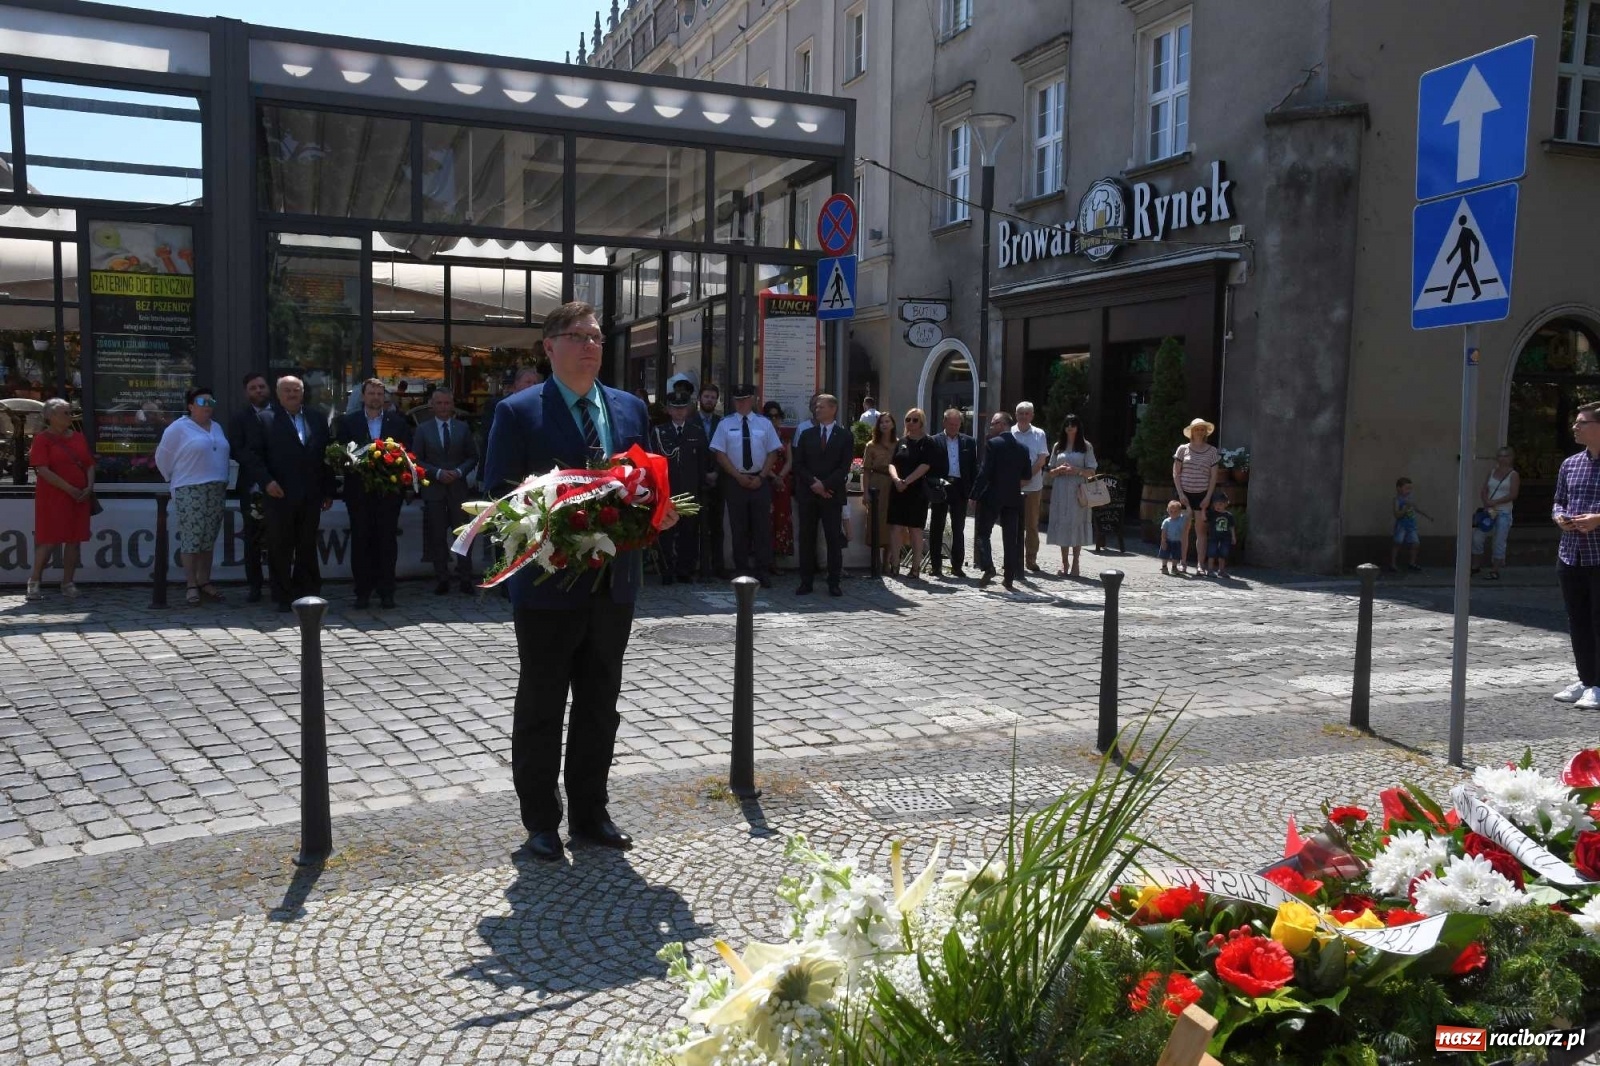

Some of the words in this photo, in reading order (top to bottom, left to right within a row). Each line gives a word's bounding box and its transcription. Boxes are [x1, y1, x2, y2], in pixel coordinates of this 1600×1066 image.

[998, 219, 1077, 269] Browar
[1132, 160, 1231, 242] Rynek
[92, 274, 134, 293] CATERING
[136, 277, 191, 295] DIETETYCZNY
[135, 300, 151, 311] BEZ
[153, 301, 191, 313] PSZENICY
[771, 299, 811, 311] LUNCH
